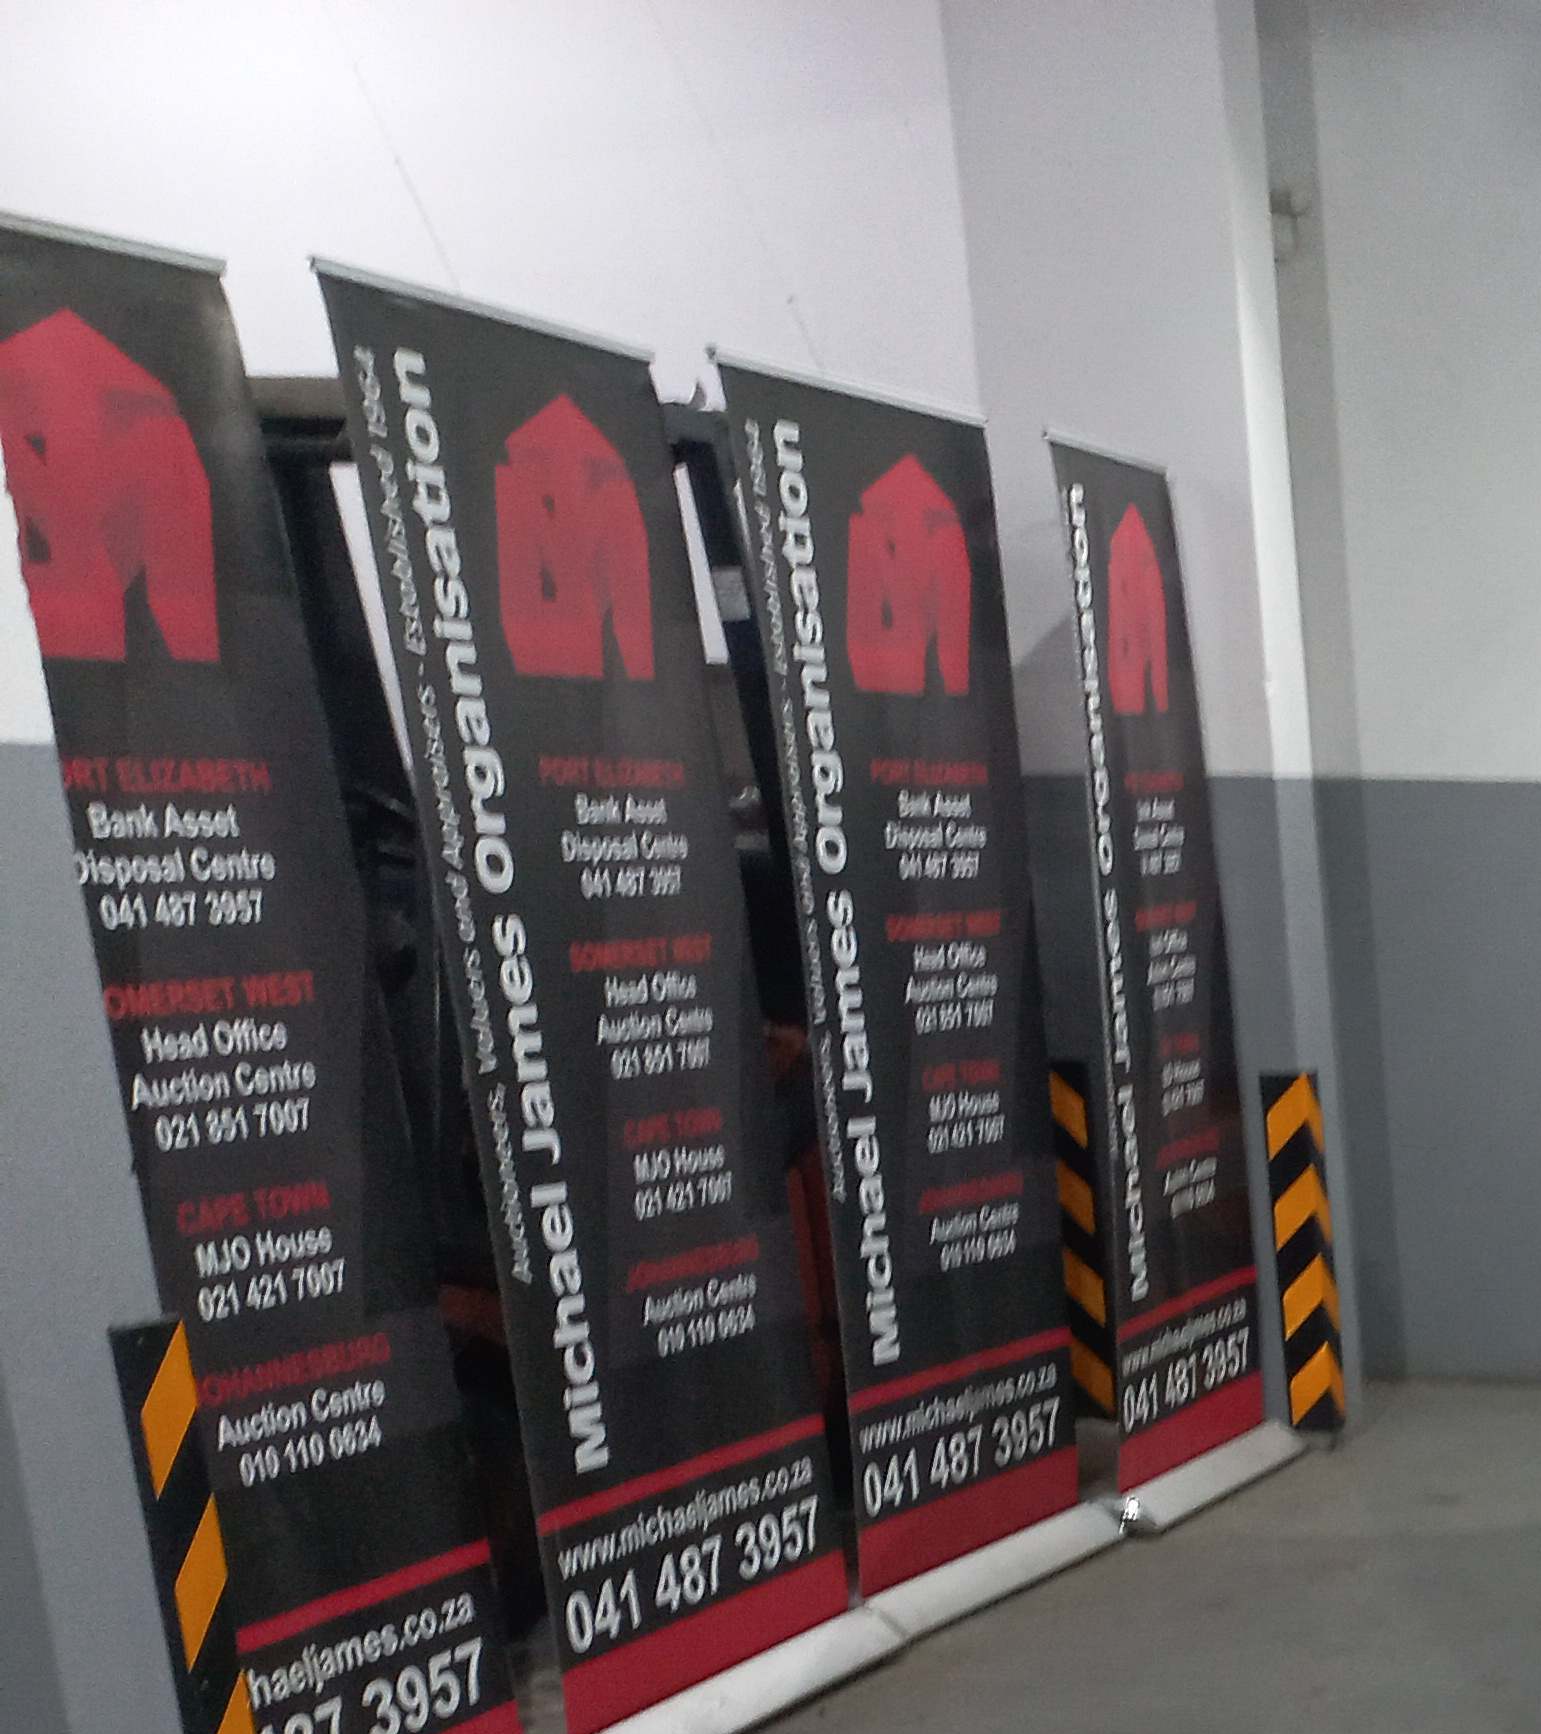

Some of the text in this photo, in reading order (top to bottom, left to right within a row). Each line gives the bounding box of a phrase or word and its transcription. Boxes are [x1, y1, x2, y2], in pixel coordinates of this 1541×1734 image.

[773, 418, 848, 875] Organisation
[87, 800, 240, 839] Bank Asset
[190, 846, 276, 882] Centre
[100, 892, 148, 930] 041
[393, 346, 609, 1474] Michael James Organisation
[826, 889, 873, 1103] James
[1103, 888, 1132, 1074] James
[141, 1017, 289, 1064] Head Office
[131, 1059, 316, 1112] Auction Centre
[155, 1111, 200, 1152] 021
[1117, 1083, 1149, 1302] Michael
[256, 1226, 333, 1266] House
[847, 1115, 901, 1366] Michael
[198, 1279, 240, 1322] 021
[218, 1380, 386, 1451] Auction Centre
[1123, 1371, 1158, 1433] 041
[1164, 1352, 1198, 1409] 487
[1202, 1326, 1250, 1390] 3957
[240, 1445, 280, 1487] 010
[284, 1432, 324, 1474] 110
[863, 1396, 1060, 1518] 041 487 3957
[565, 1494, 818, 1654] 041 487 3957
[247, 1592, 476, 1710] haeljames.co.za
